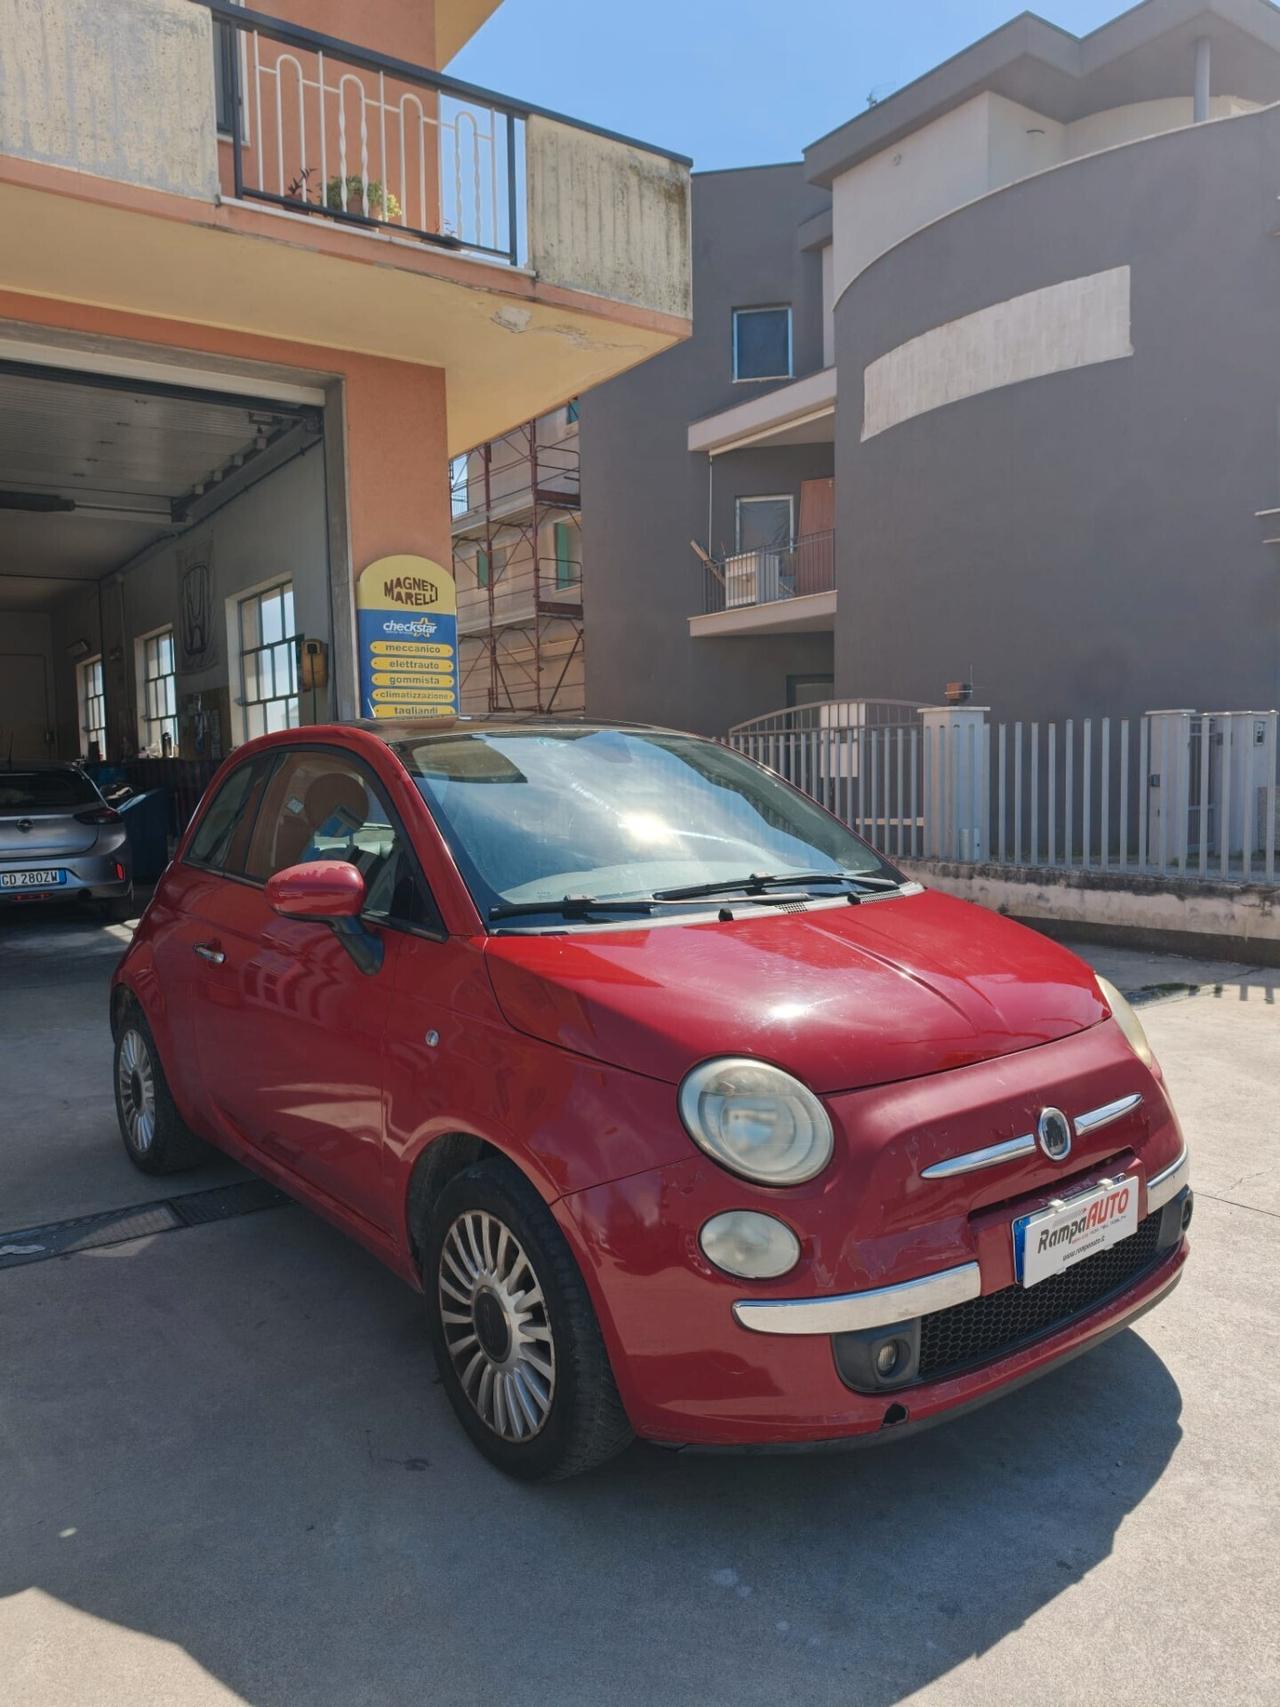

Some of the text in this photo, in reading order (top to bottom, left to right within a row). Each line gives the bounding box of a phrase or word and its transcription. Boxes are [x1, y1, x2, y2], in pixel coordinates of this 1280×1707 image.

[383, 620, 437, 634] checkstar
[385, 643, 441, 654] meccanico
[389, 660, 439, 670] elettrauto
[389, 676, 440, 685] gommista
[380, 691, 448, 700] climatizzazione
[394, 706, 438, 715] tagliandi
[1038, 1188, 1129, 1254] RampaAUTO
